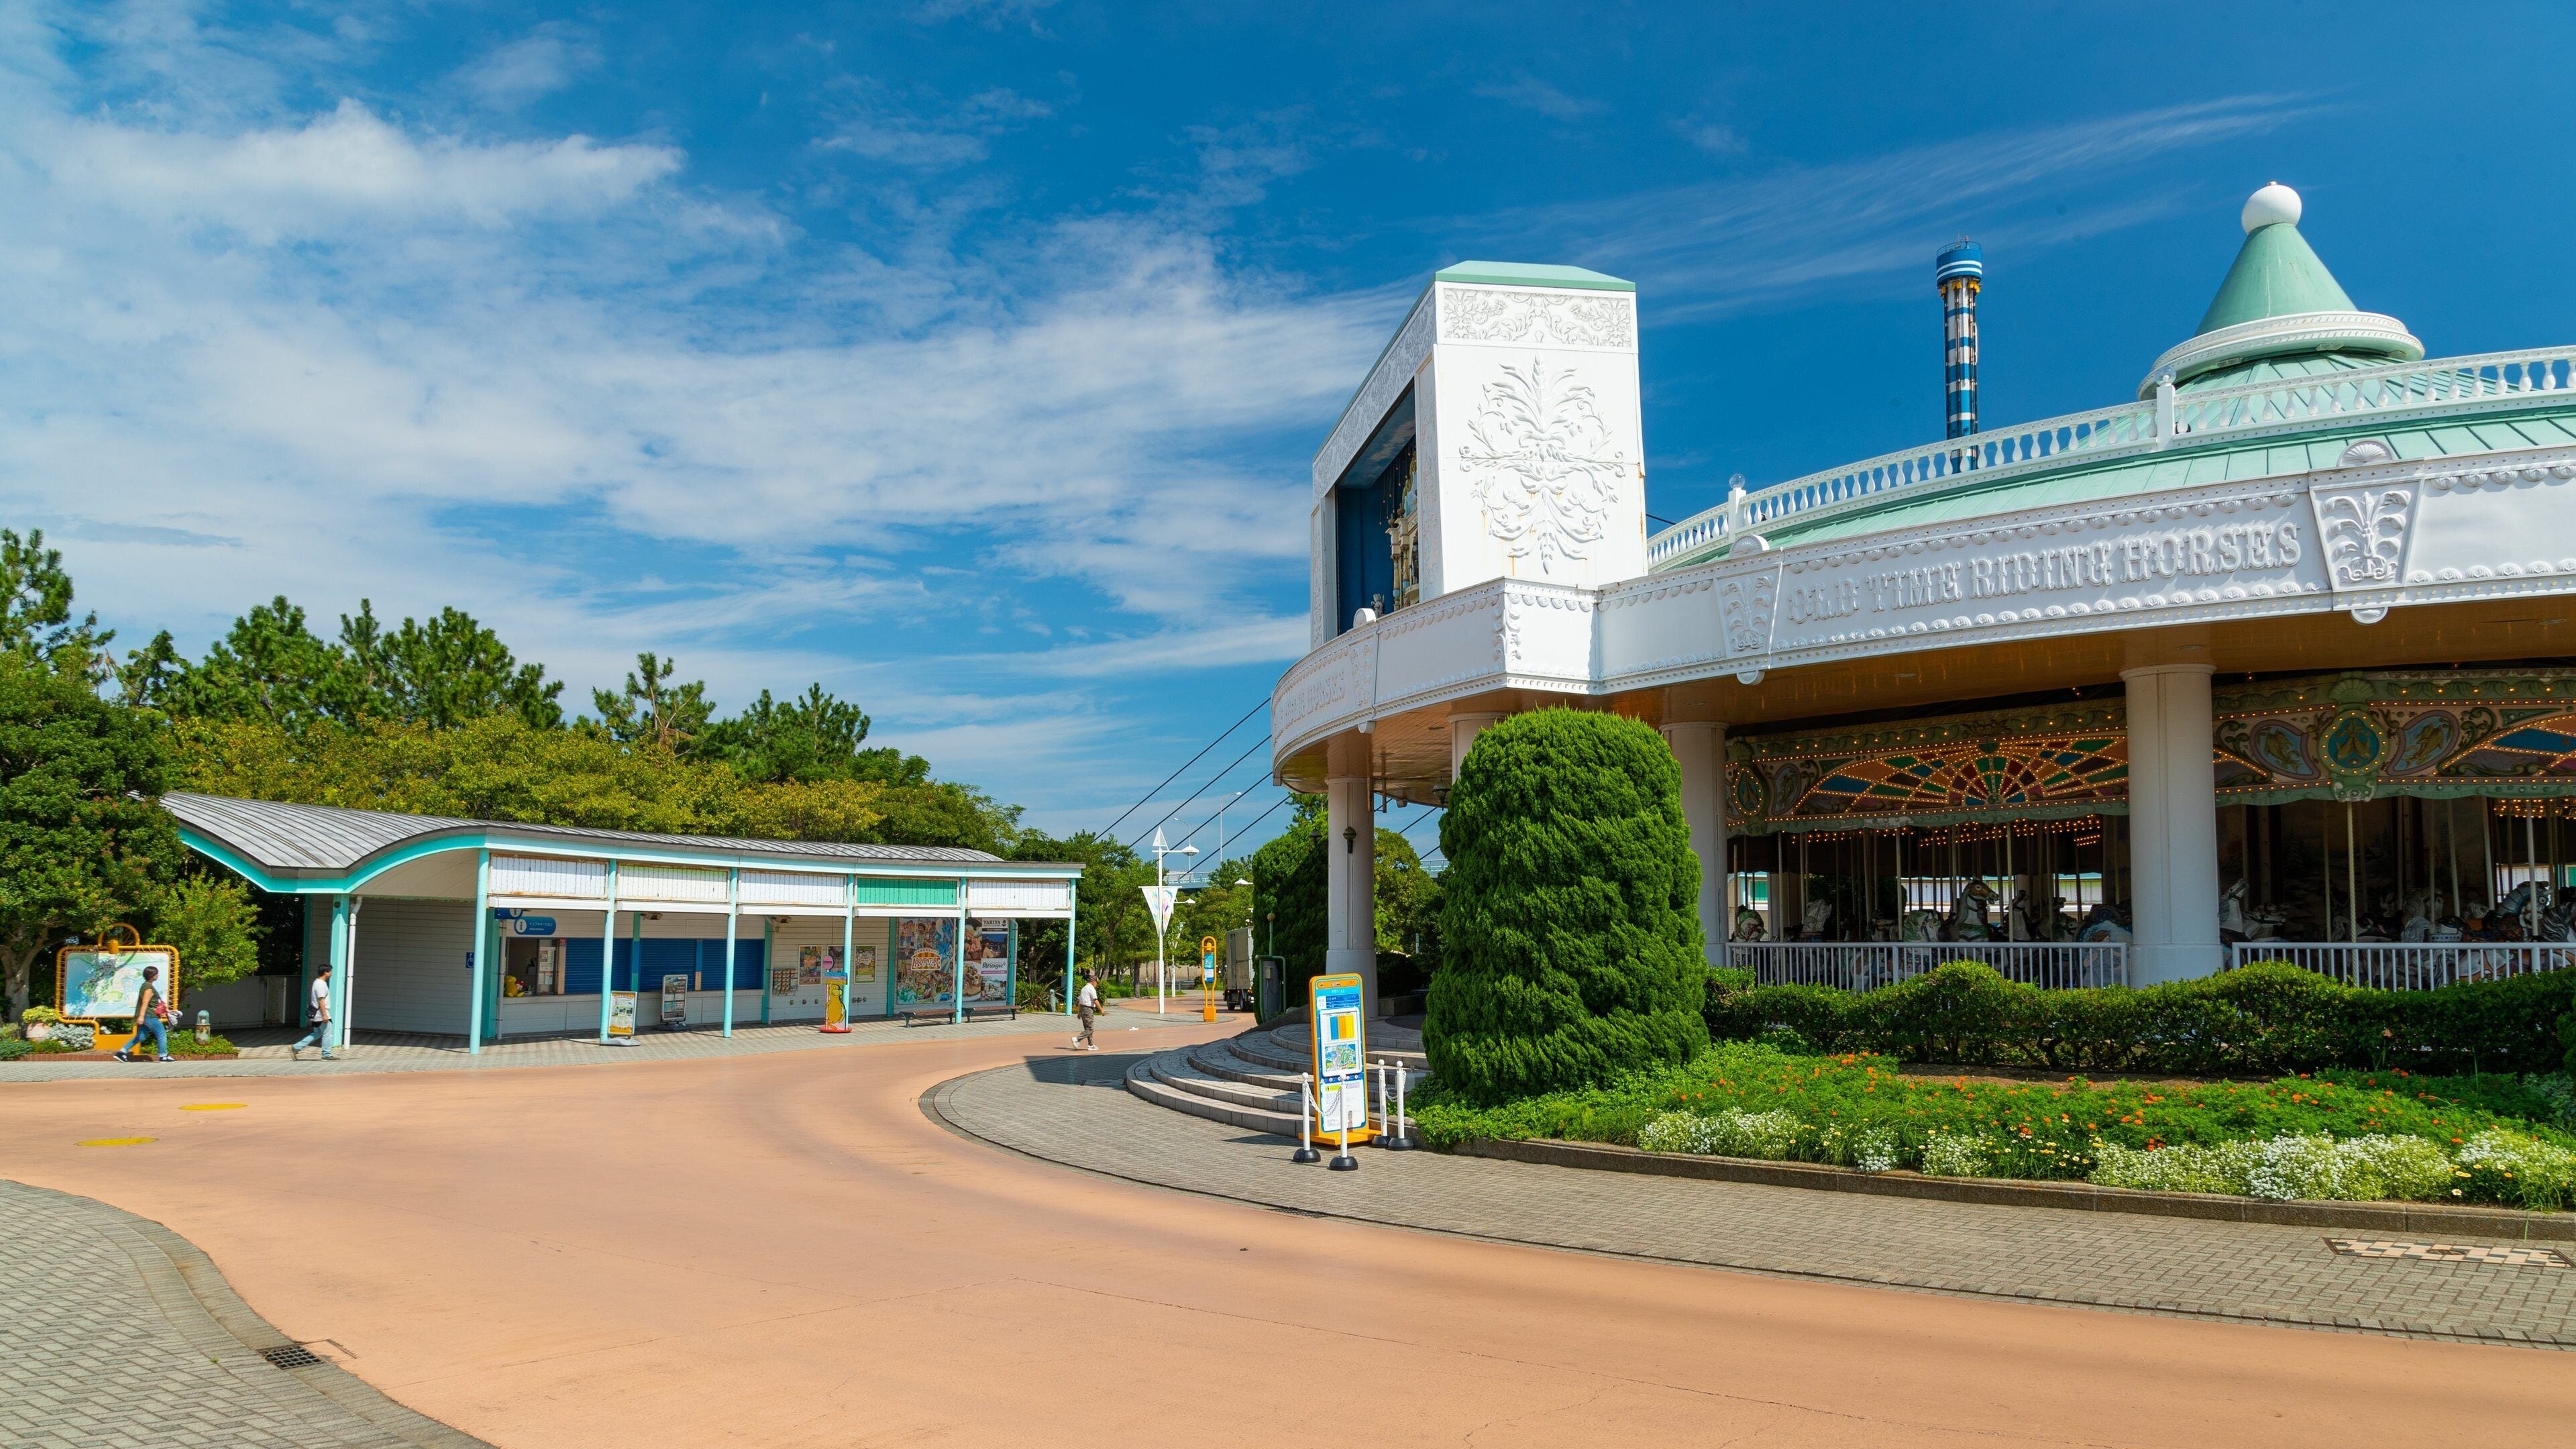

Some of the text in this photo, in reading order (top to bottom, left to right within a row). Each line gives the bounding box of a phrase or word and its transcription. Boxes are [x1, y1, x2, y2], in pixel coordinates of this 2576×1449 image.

[1787, 522, 2302, 624] OLD TIME RIDING HORSES
